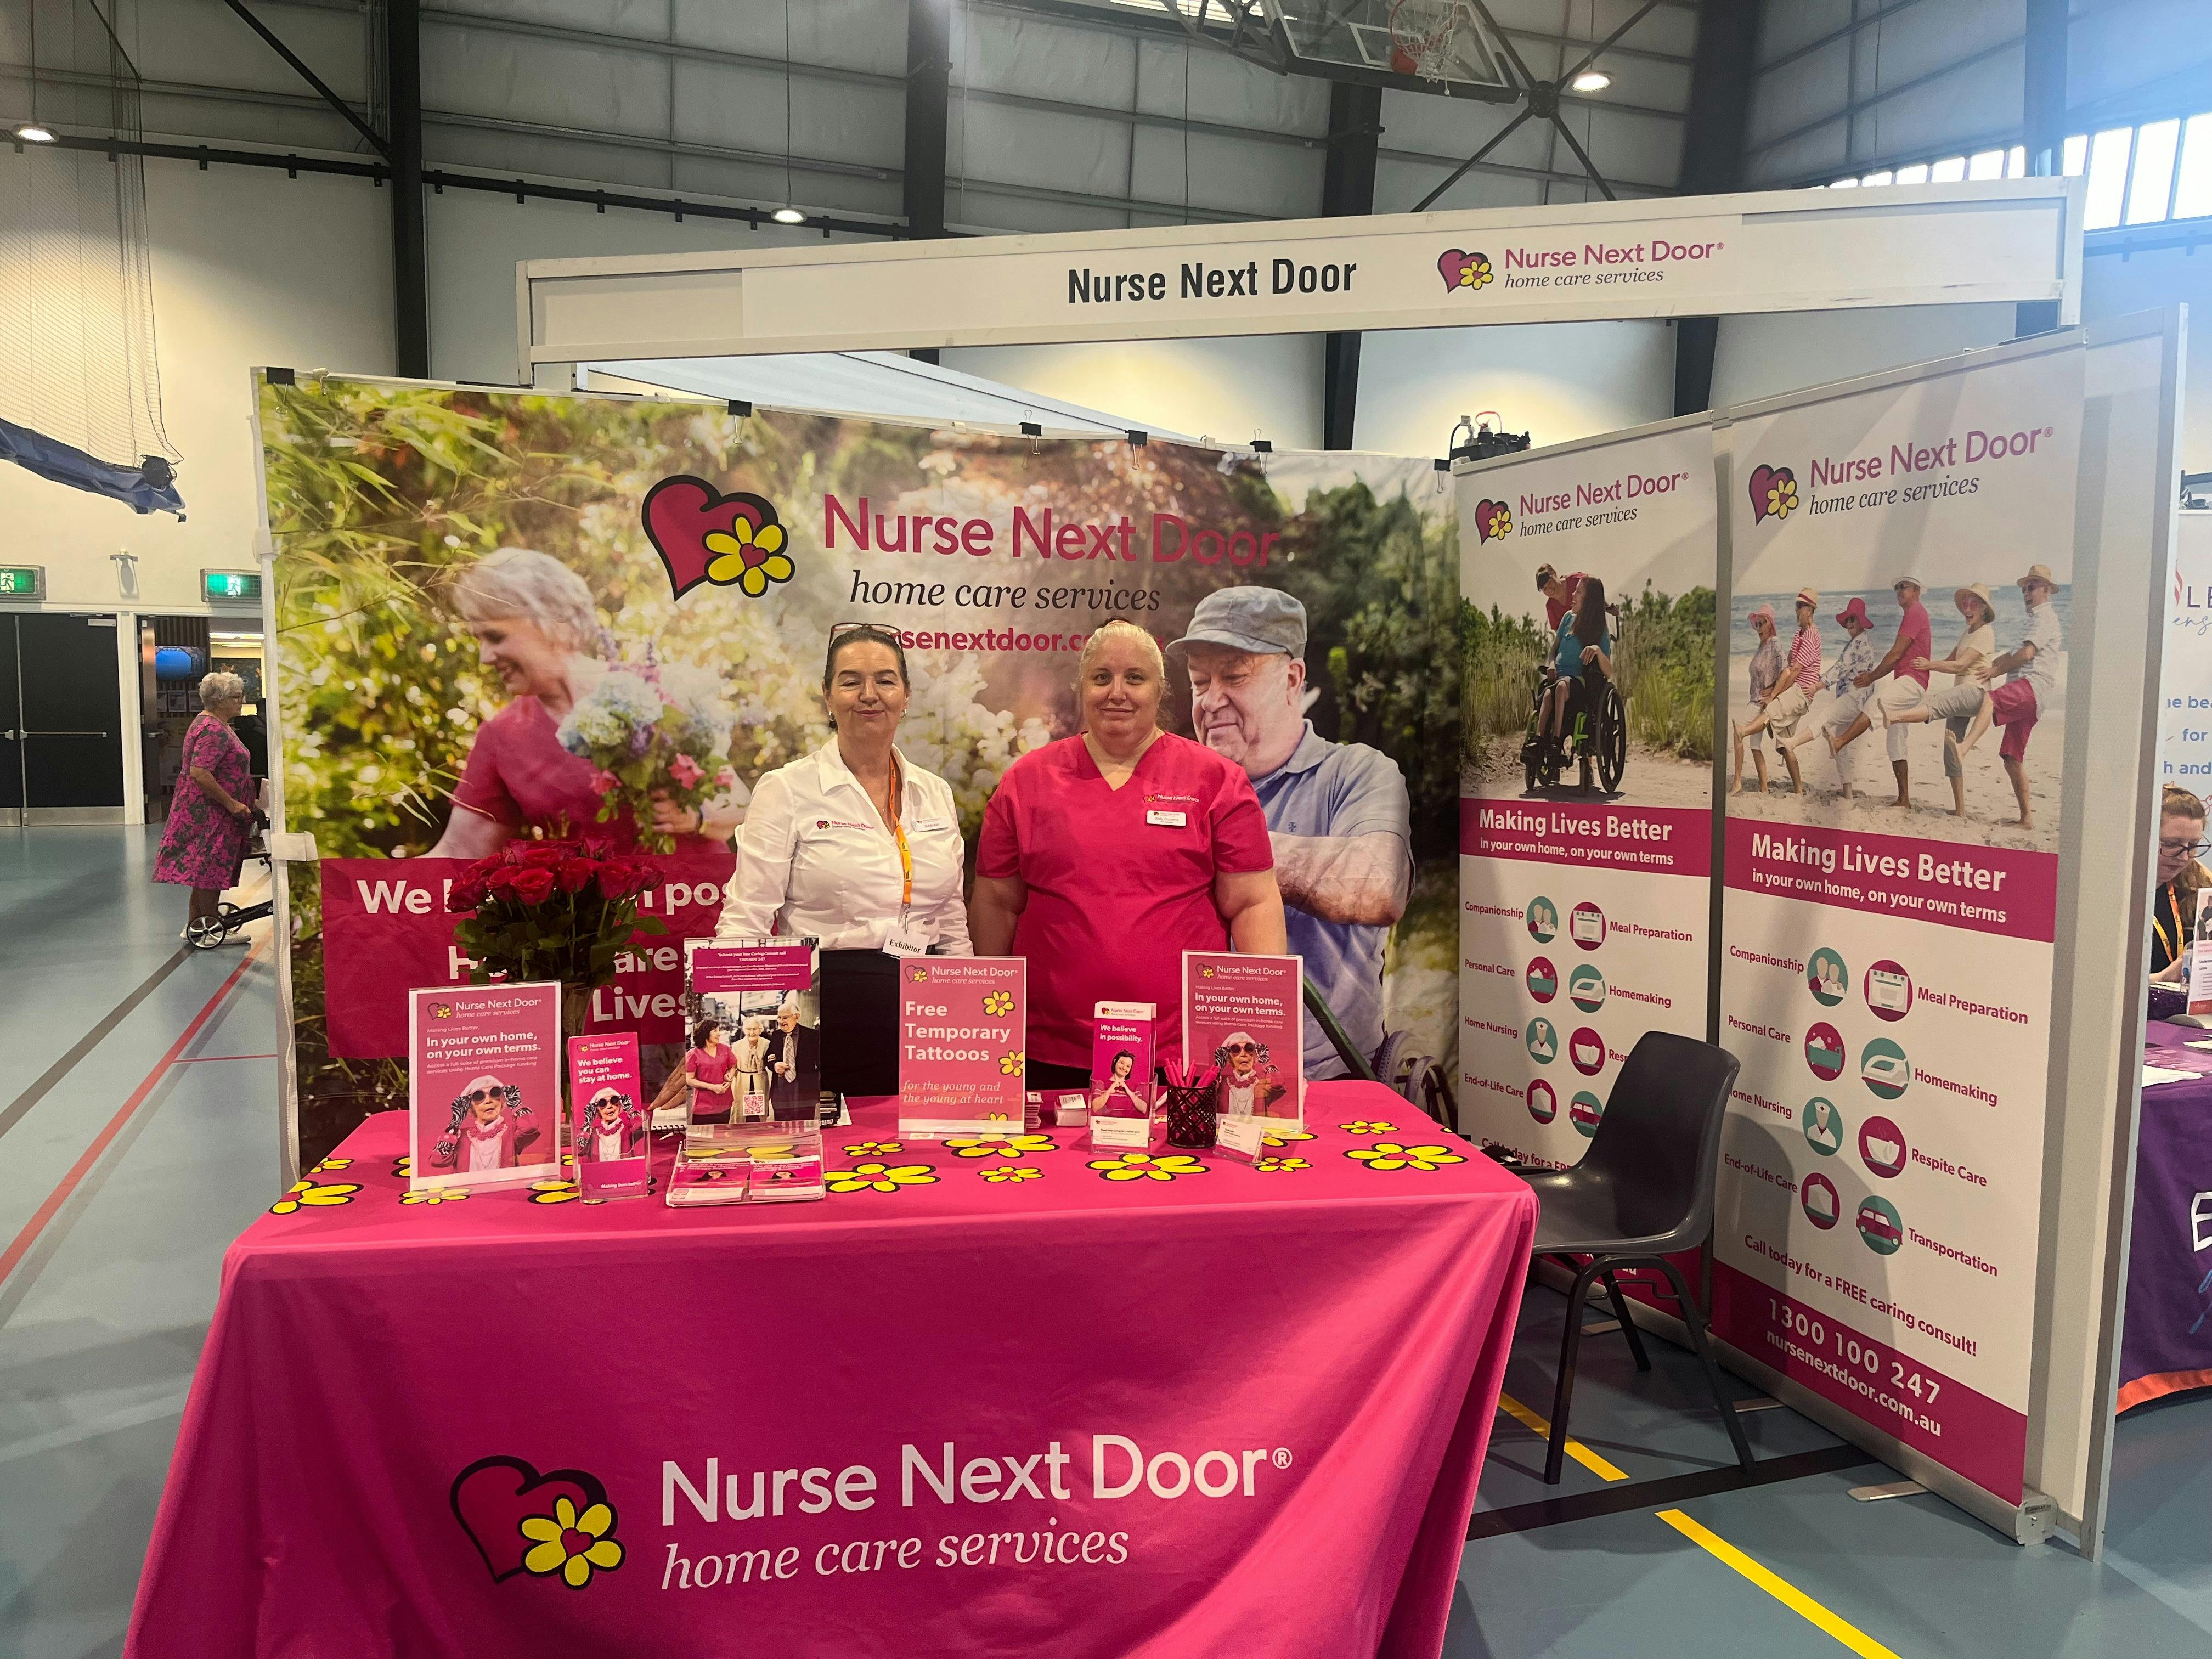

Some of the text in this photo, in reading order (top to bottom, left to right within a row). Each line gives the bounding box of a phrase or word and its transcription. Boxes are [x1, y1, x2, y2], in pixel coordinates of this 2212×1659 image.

[1505, 246, 1576, 270] Nurse
[1584, 242, 1645, 266] Next
[1069, 257, 1357, 304] Nurse Next Door
[1504, 266, 1663, 290] home care services
[1810, 452, 1881, 488] Nurse
[1890, 438, 1957, 474] Next
[1519, 490, 1570, 517] Nurse
[1576, 483, 1622, 507] Next
[1809, 476, 1979, 516] home care services
[825, 494, 1280, 567] Nurse Next Door
[1519, 506, 1637, 538] home care services
[850, 570, 1161, 612] home care services
[2183, 729, 2208, 741] for
[2179, 762, 2211, 774] and
[1480, 809, 1672, 841] Making Lives Better
[1480, 838, 1673, 865] in your own home, on your own terms
[1752, 834, 2006, 891] Making Lives Better
[357, 880, 431, 915] We
[1753, 868, 2006, 923] in your own home, on your own terms
[1465, 902, 1524, 920] Companionship
[1610, 921, 1692, 942] Meal Preparation
[889, 939, 921, 953] Exhibitor
[932, 967, 961, 977] Nurse
[963, 967, 987, 976] Next
[1217, 965, 1240, 974] Nurse
[1465, 960, 1515, 977] Personal Care
[1730, 945, 1804, 974] Companionship
[456, 1002, 485, 1011] Nurse
[488, 1000, 512, 1008] Next
[905, 1001, 948, 1017] Free
[1195, 992, 1204, 1001] In
[1206, 995, 1228, 1003] your
[1252, 996, 1283, 1007] home,
[1609, 985, 1671, 1008] Homemaking
[1918, 987, 2028, 1025] Meal Preparation
[1255, 1007, 1286, 1016] terms.
[427, 1032, 537, 1048] In your own home,
[905, 1023, 1011, 1043] Temporary
[1107, 1034, 1143, 1043] possibility.
[1465, 1017, 1517, 1039] Home Nursing
[1728, 1015, 1791, 1043] Personal Care
[427, 1043, 541, 1059] on your own terms.
[592, 1057, 623, 1065] believe
[905, 1045, 989, 1062] Tattooos
[578, 1068, 594, 1076] you
[901, 1080, 1001, 1093] for the young and
[1465, 1073, 1523, 1098] End-of-Life Care
[1915, 1068, 1997, 1107] Homemaking
[904, 1093, 1004, 1105] the young at heart
[1730, 1090, 1792, 1119] ome Nursing
[1531, 1153, 1545, 1165] for
[1912, 1148, 1987, 1187] Respite Care
[1724, 1153, 1798, 1193] End-of-Life Care
[1909, 1227, 1997, 1277] Transportation
[1745, 1234, 1977, 1357] Call today for a FREE caring consult!
[1769, 1298, 1940, 1404] 1300 100 247
[1767, 1329, 1940, 1437] nursenextdoor.com.au
[660, 1458, 876, 1527] Nurse
[902, 1440, 1070, 1509] Next
[661, 1515, 1128, 1591] home care services
